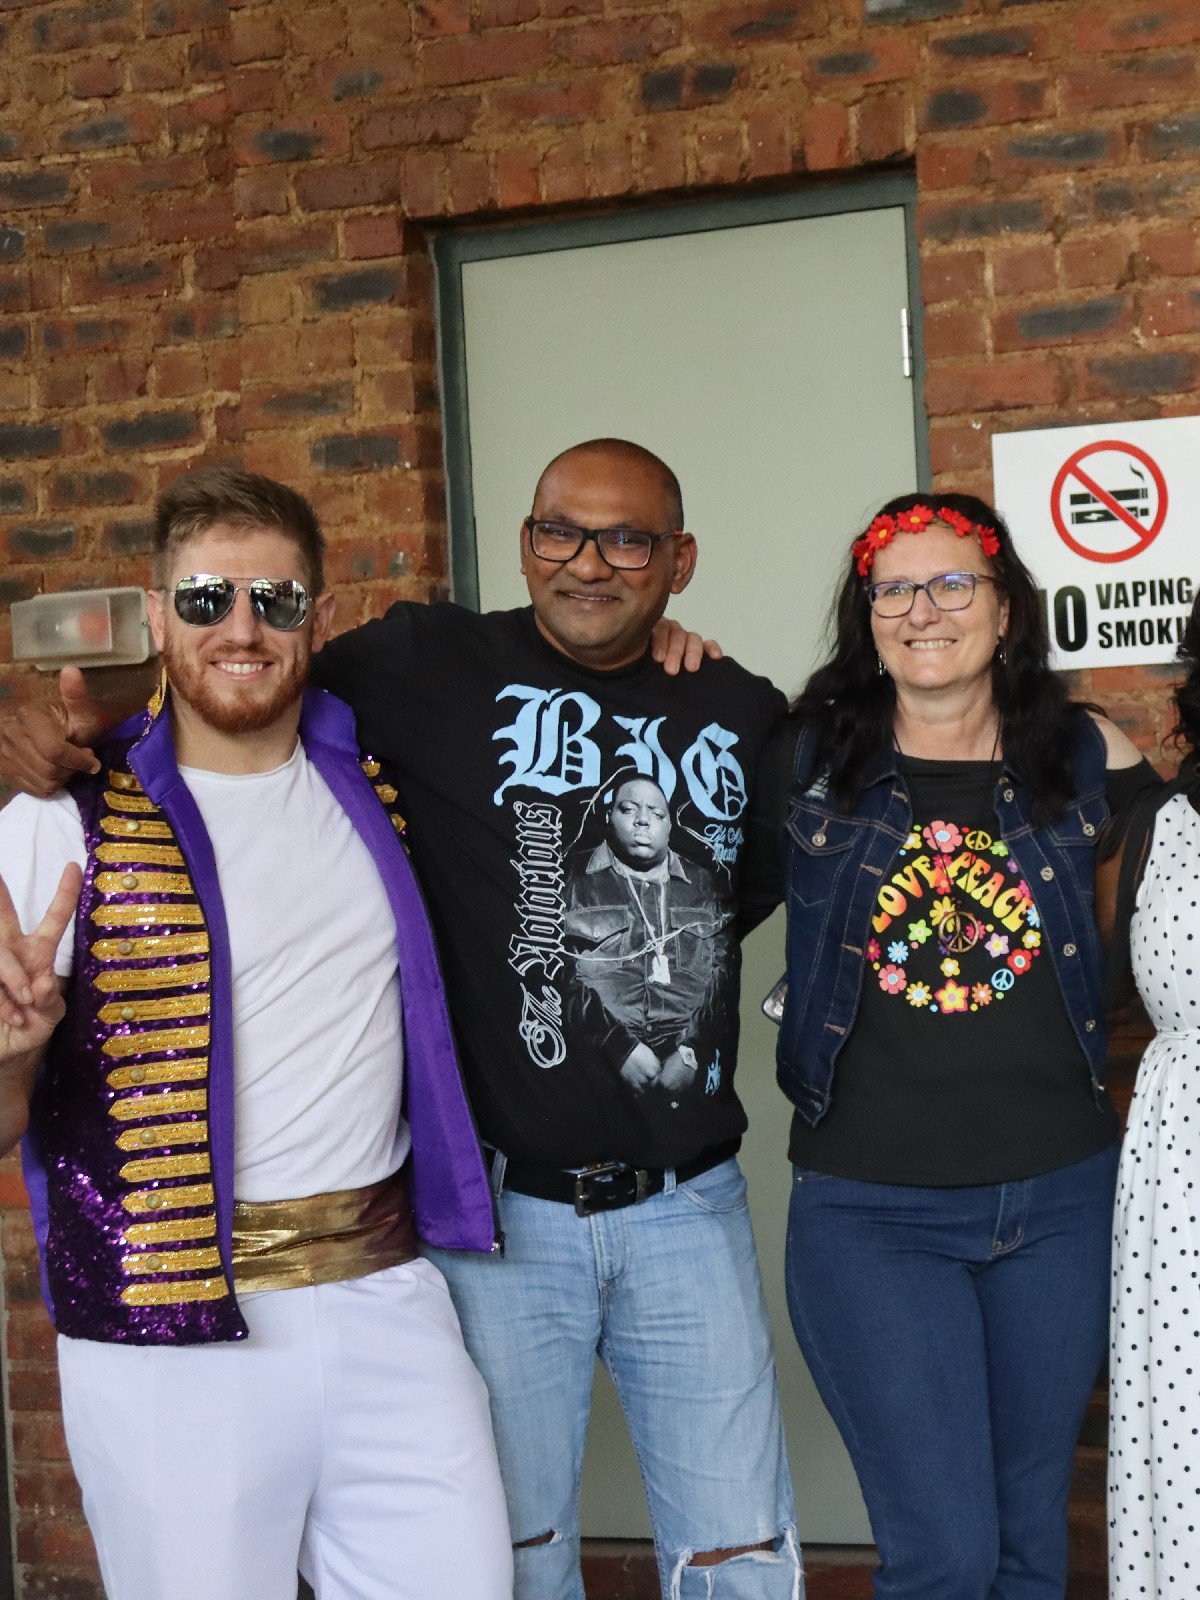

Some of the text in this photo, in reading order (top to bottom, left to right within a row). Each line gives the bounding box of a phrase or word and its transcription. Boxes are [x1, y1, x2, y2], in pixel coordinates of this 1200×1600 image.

[1096, 577, 1192, 610] VAPING
[1097, 616, 1191, 648] SMOKI
[492, 684, 748, 821] BIG
[946, 851, 1034, 932] PEACE
[508, 800, 568, 1069] The Notorious
